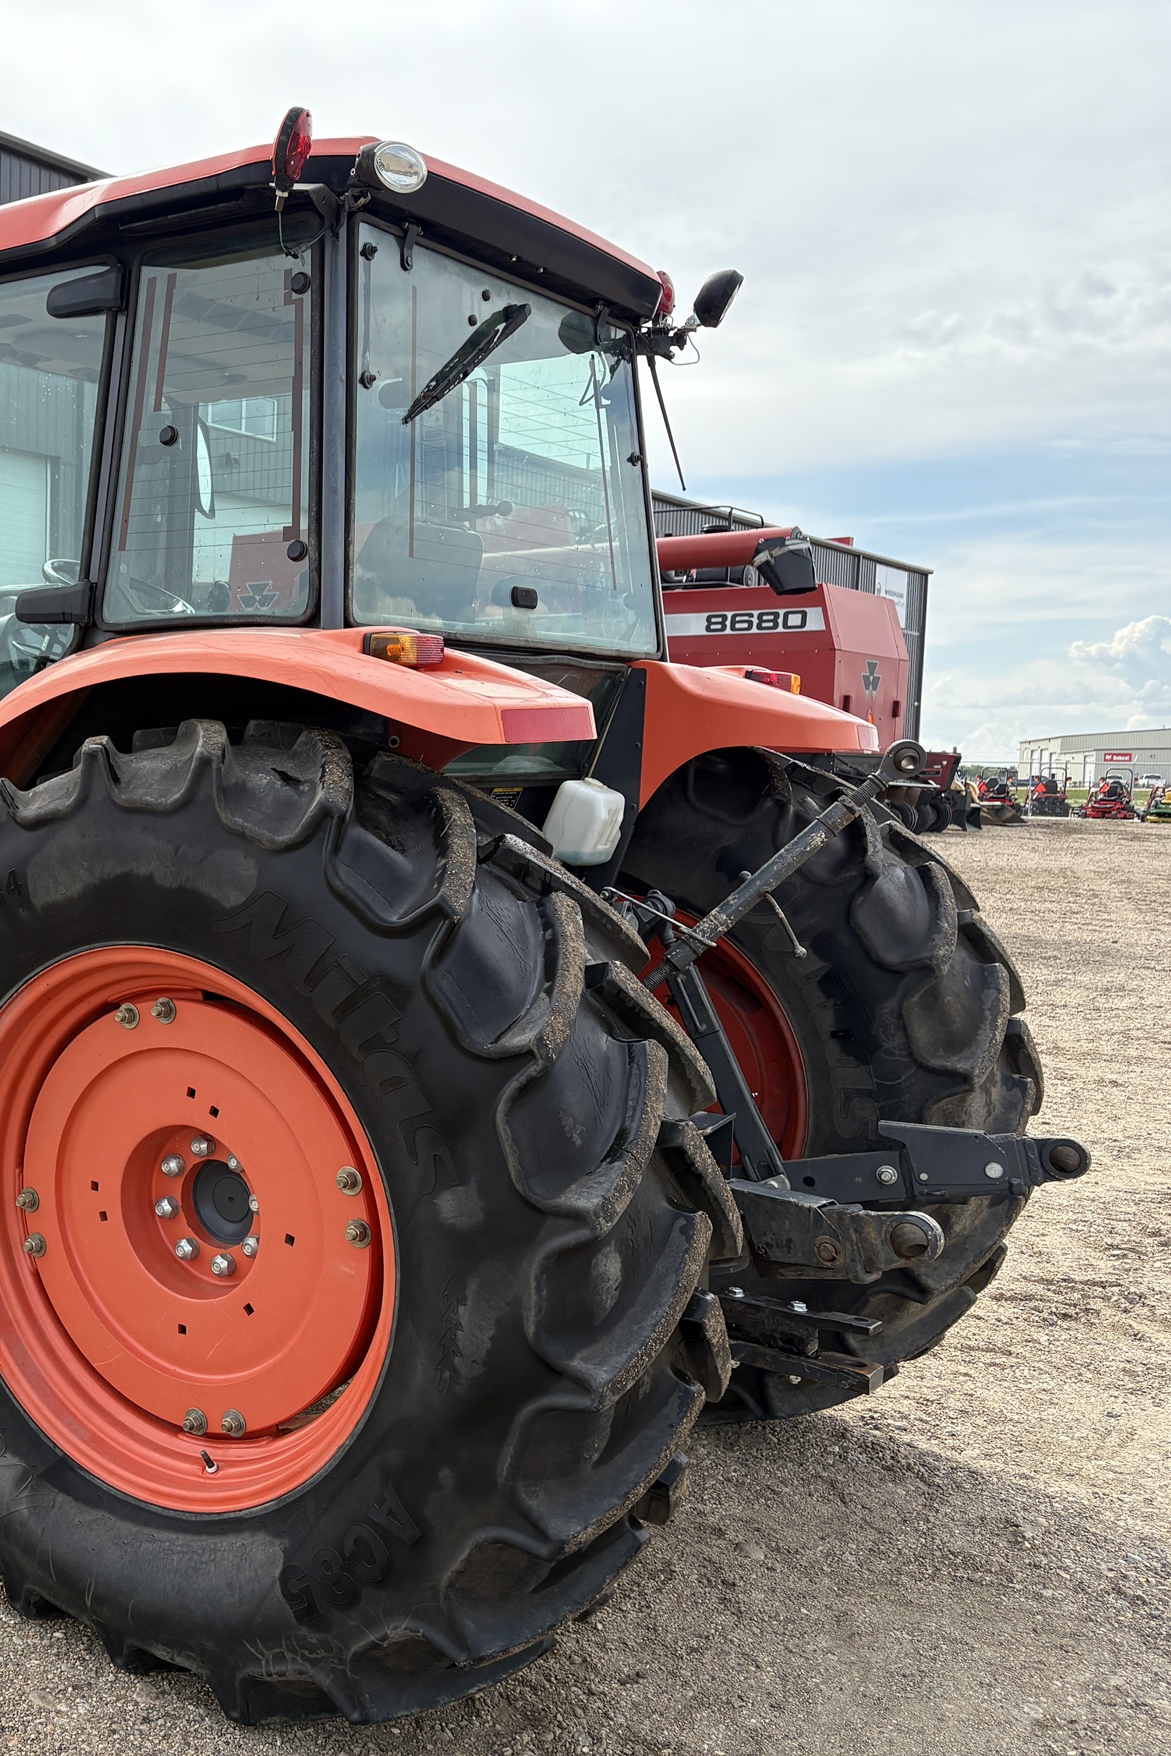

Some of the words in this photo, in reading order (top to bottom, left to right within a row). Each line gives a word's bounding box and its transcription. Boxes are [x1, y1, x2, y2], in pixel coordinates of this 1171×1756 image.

[705, 610, 808, 632] 8680
[211, 889, 461, 1196] Mitas
[279, 1482, 422, 1624] AC85
